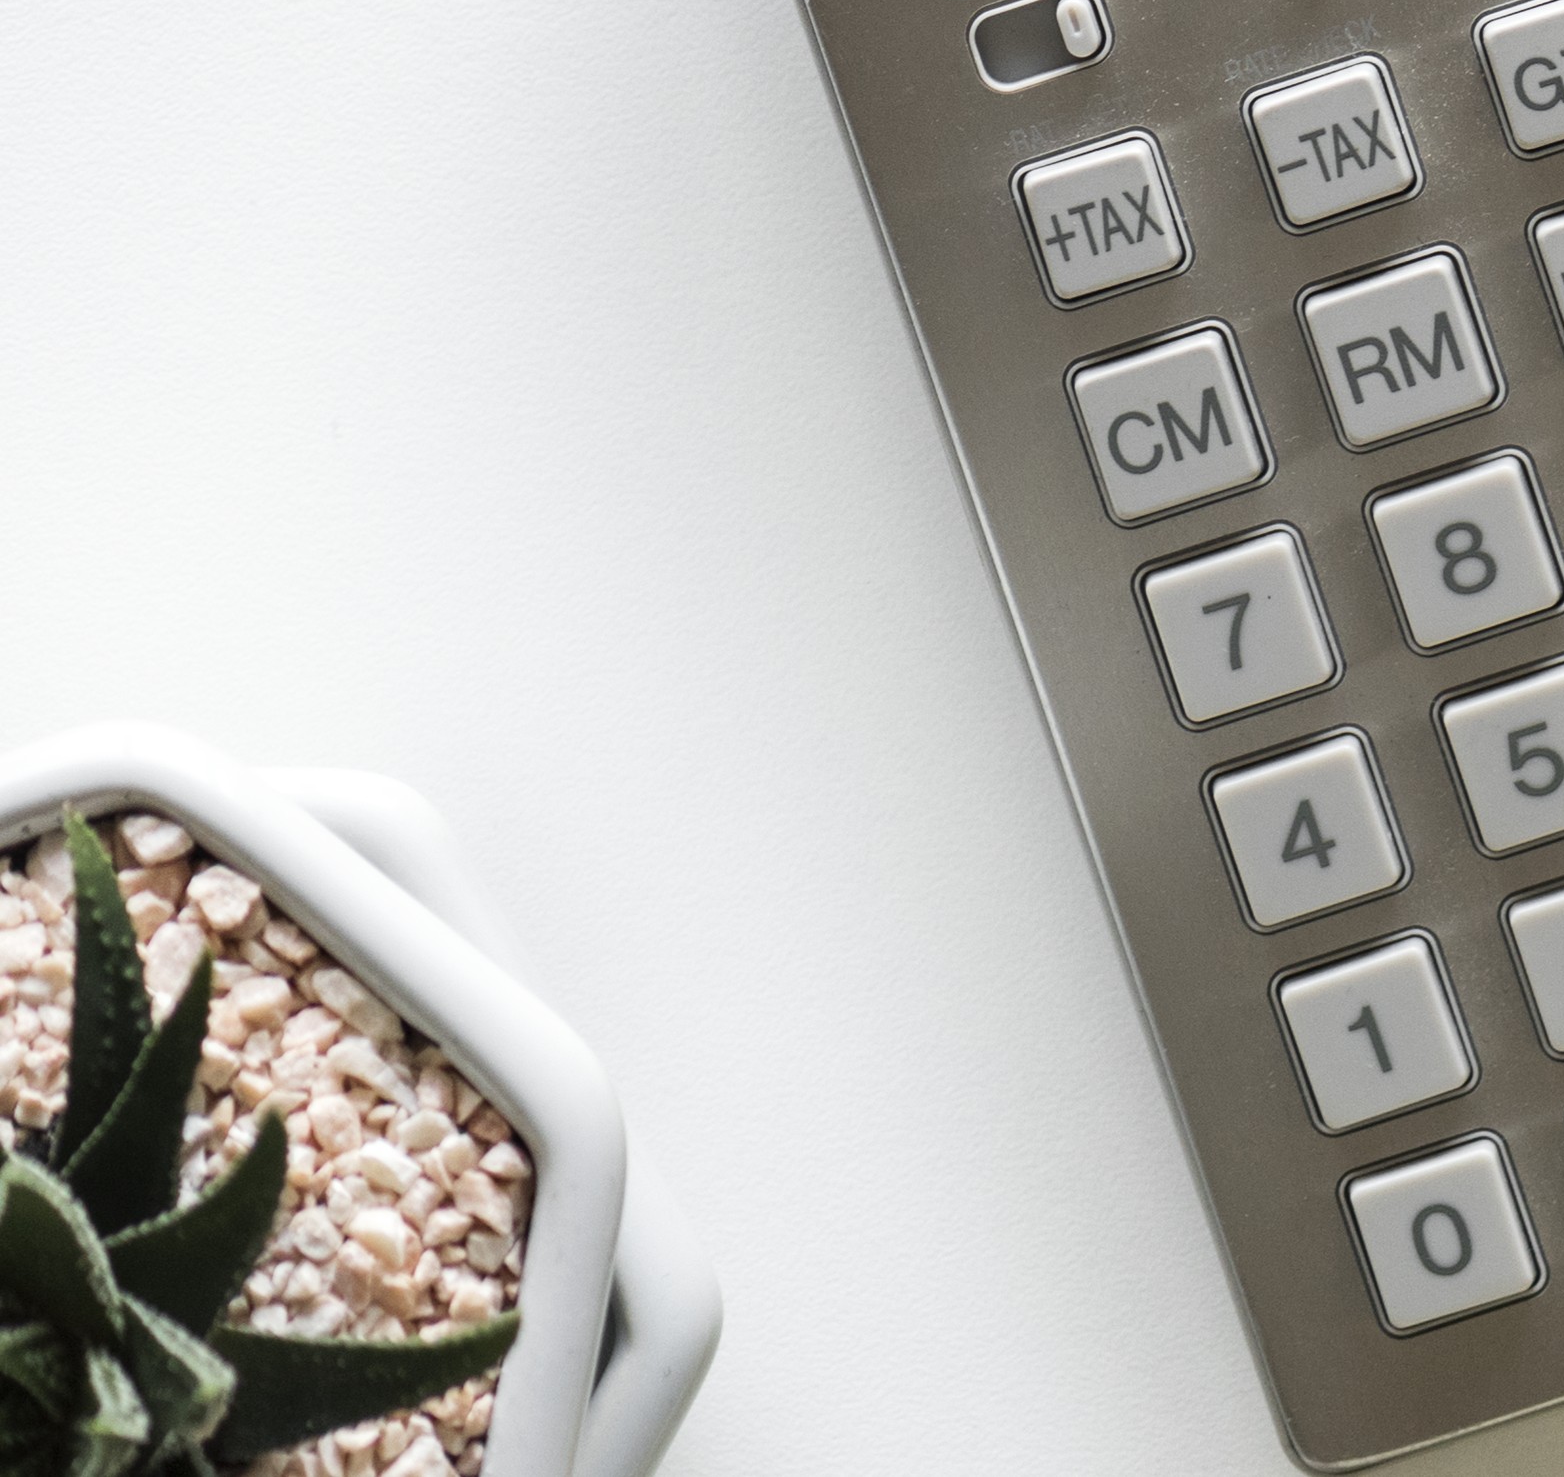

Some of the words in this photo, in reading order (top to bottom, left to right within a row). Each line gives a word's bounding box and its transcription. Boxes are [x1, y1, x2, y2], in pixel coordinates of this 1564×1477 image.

[1045, 183, 1165, 263] +TAX
[1336, 311, 1466, 405] RM
[1107, 386, 1234, 475] CM
[1435, 522, 1497, 595] 8
[1202, 592, 1251, 671] 7
[1281, 799, 1336, 868] 4
[1348, 1005, 1392, 1073] 1
[1412, 1203, 1472, 1276] 0
